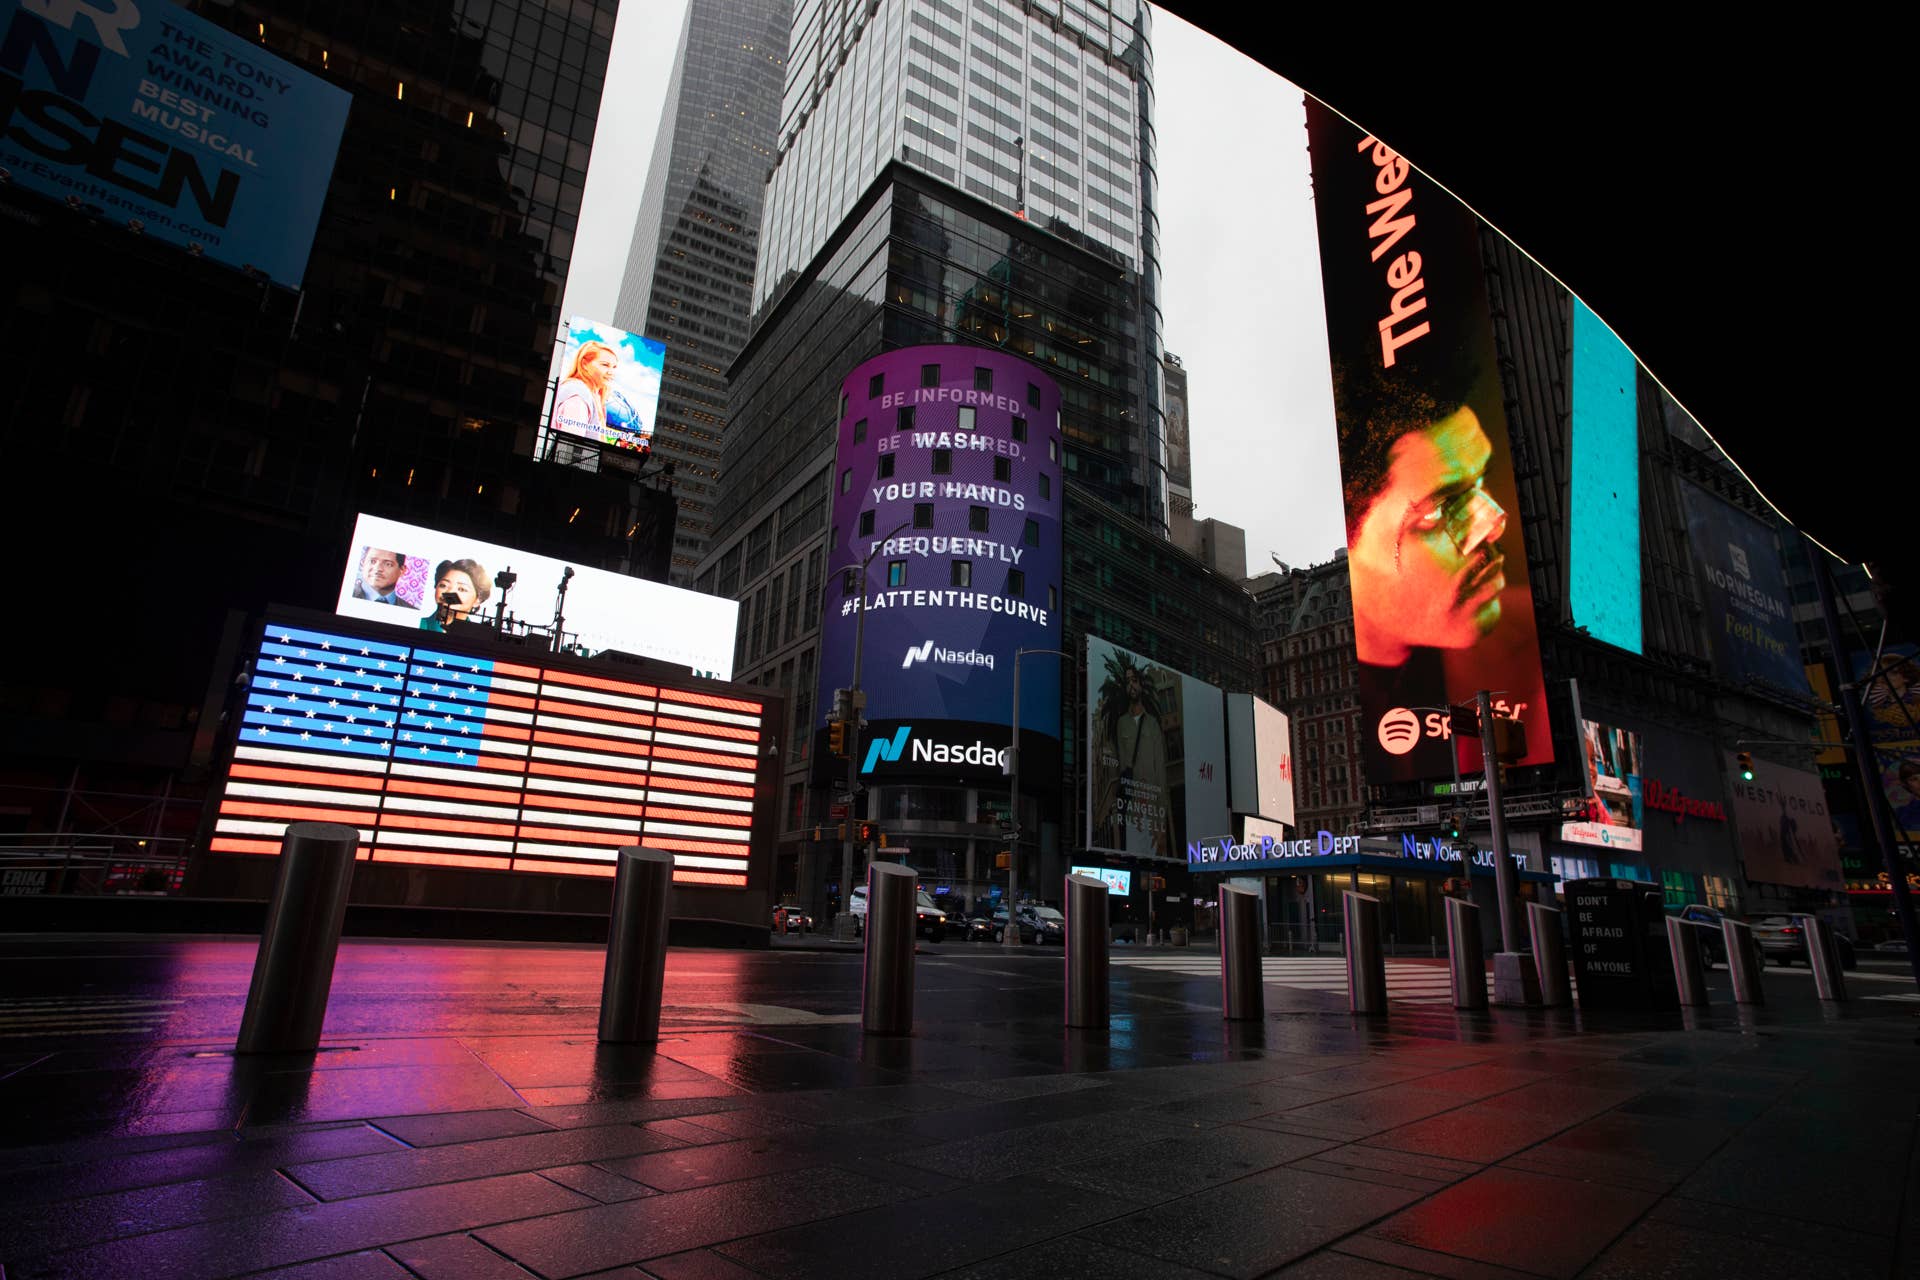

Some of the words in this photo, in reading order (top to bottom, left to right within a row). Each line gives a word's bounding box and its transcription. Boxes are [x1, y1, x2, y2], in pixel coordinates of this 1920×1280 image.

[152, 43, 265, 102] AWARD-
[160, 21, 213, 60] THE
[222, 51, 291, 95] TONY
[138, 79, 216, 125] BEST
[146, 58, 270, 129] WINNING
[131, 98, 259, 168] MUSICAL
[1377, 249, 1432, 369] The
[881, 391, 905, 410] BE
[914, 388, 1026, 419] INFORMED,
[557, 414, 650, 446] SupremeMasterTV.com
[877, 434, 901, 453] BE
[914, 431, 987, 452] WASH
[872, 481, 935, 504] YOUR
[945, 481, 1026, 512] HANDS
[870, 536, 1024, 565] FREQUENTLY
[1704, 562, 1786, 620] NORWEGIAN
[841, 589, 1048, 627] #FLATTENTHECURVE
[1725, 612, 1753, 641] Feel
[1755, 626, 1786, 657] Free
[934, 647, 995, 672] Nasdaq
[1116, 797, 1167, 819] D'ANGELO
[1643, 778, 1729, 824] Walgreens
[1733, 782, 1825, 817] WESTWORLD
[1187, 840, 1219, 864] NEW
[1219, 838, 1258, 862] YORK
[1261, 835, 1312, 859] POLICE
[1317, 830, 1361, 856] DEPT
[1, 869, 48, 887] ERIKA
[1576, 895, 1609, 907] DON'T
[1578, 911, 1593, 923] BE
[1581, 927, 1624, 938] AFRAID
[1583, 943, 1599, 955] OF
[1585, 960, 1633, 974] ANYONE
